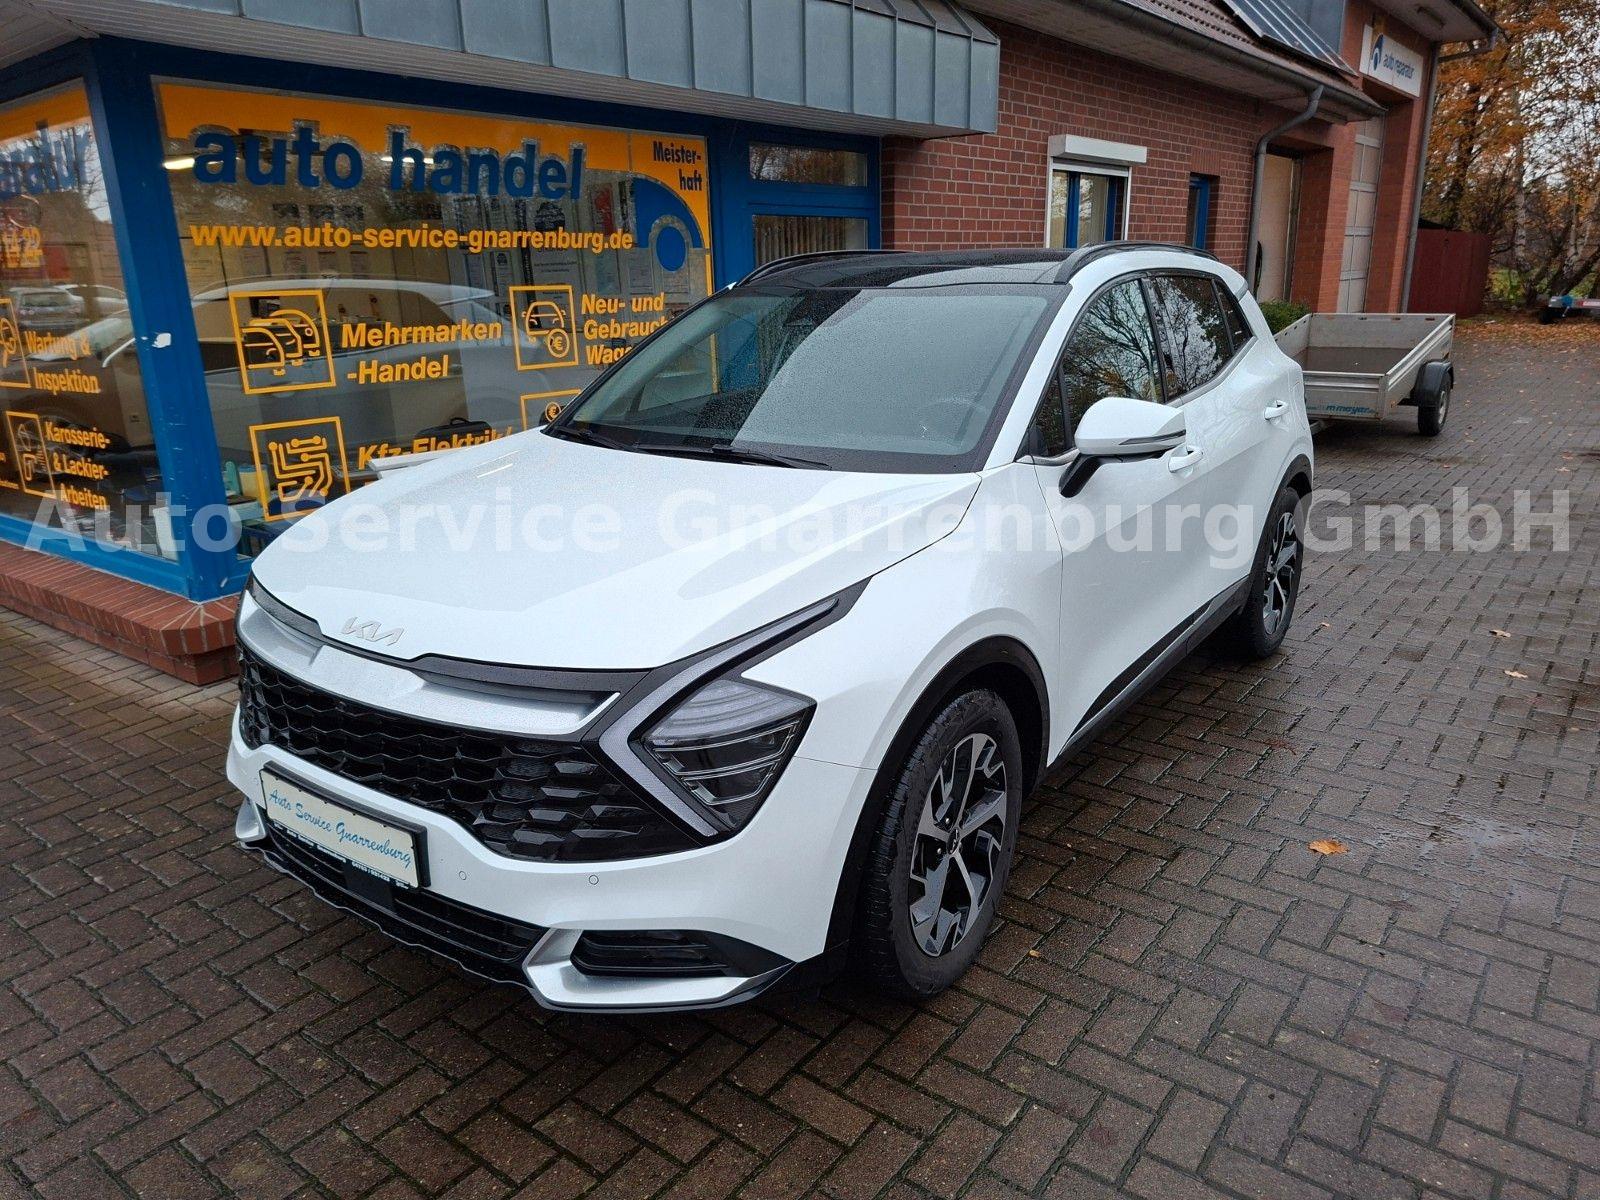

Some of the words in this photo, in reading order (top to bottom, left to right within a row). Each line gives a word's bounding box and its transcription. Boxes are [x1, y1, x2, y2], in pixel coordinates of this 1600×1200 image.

[193, 126, 363, 190] auto
[389, 131, 585, 200] handel
[653, 141, 702, 165] Meister-
[679, 168, 703, 191] haft
[189, 222, 633, 254] www.auto-service-gnarrenburg.de
[581, 293, 626, 314] Neu-
[632, 291, 665, 313] und
[341, 318, 502, 348] Mehrmarken
[33, 366, 101, 396] Inspektion
[347, 355, 449, 385] -Handel
[45, 421, 111, 449] Karosserie-
[53, 452, 61, 472] &
[62, 454, 109, 480] Lackier-
[60, 482, 107, 510] Arbeiten
[269, 789, 292, 811] Auto
[295, 802, 332, 833] Service
[336, 822, 412, 869] Gnarrenburg
